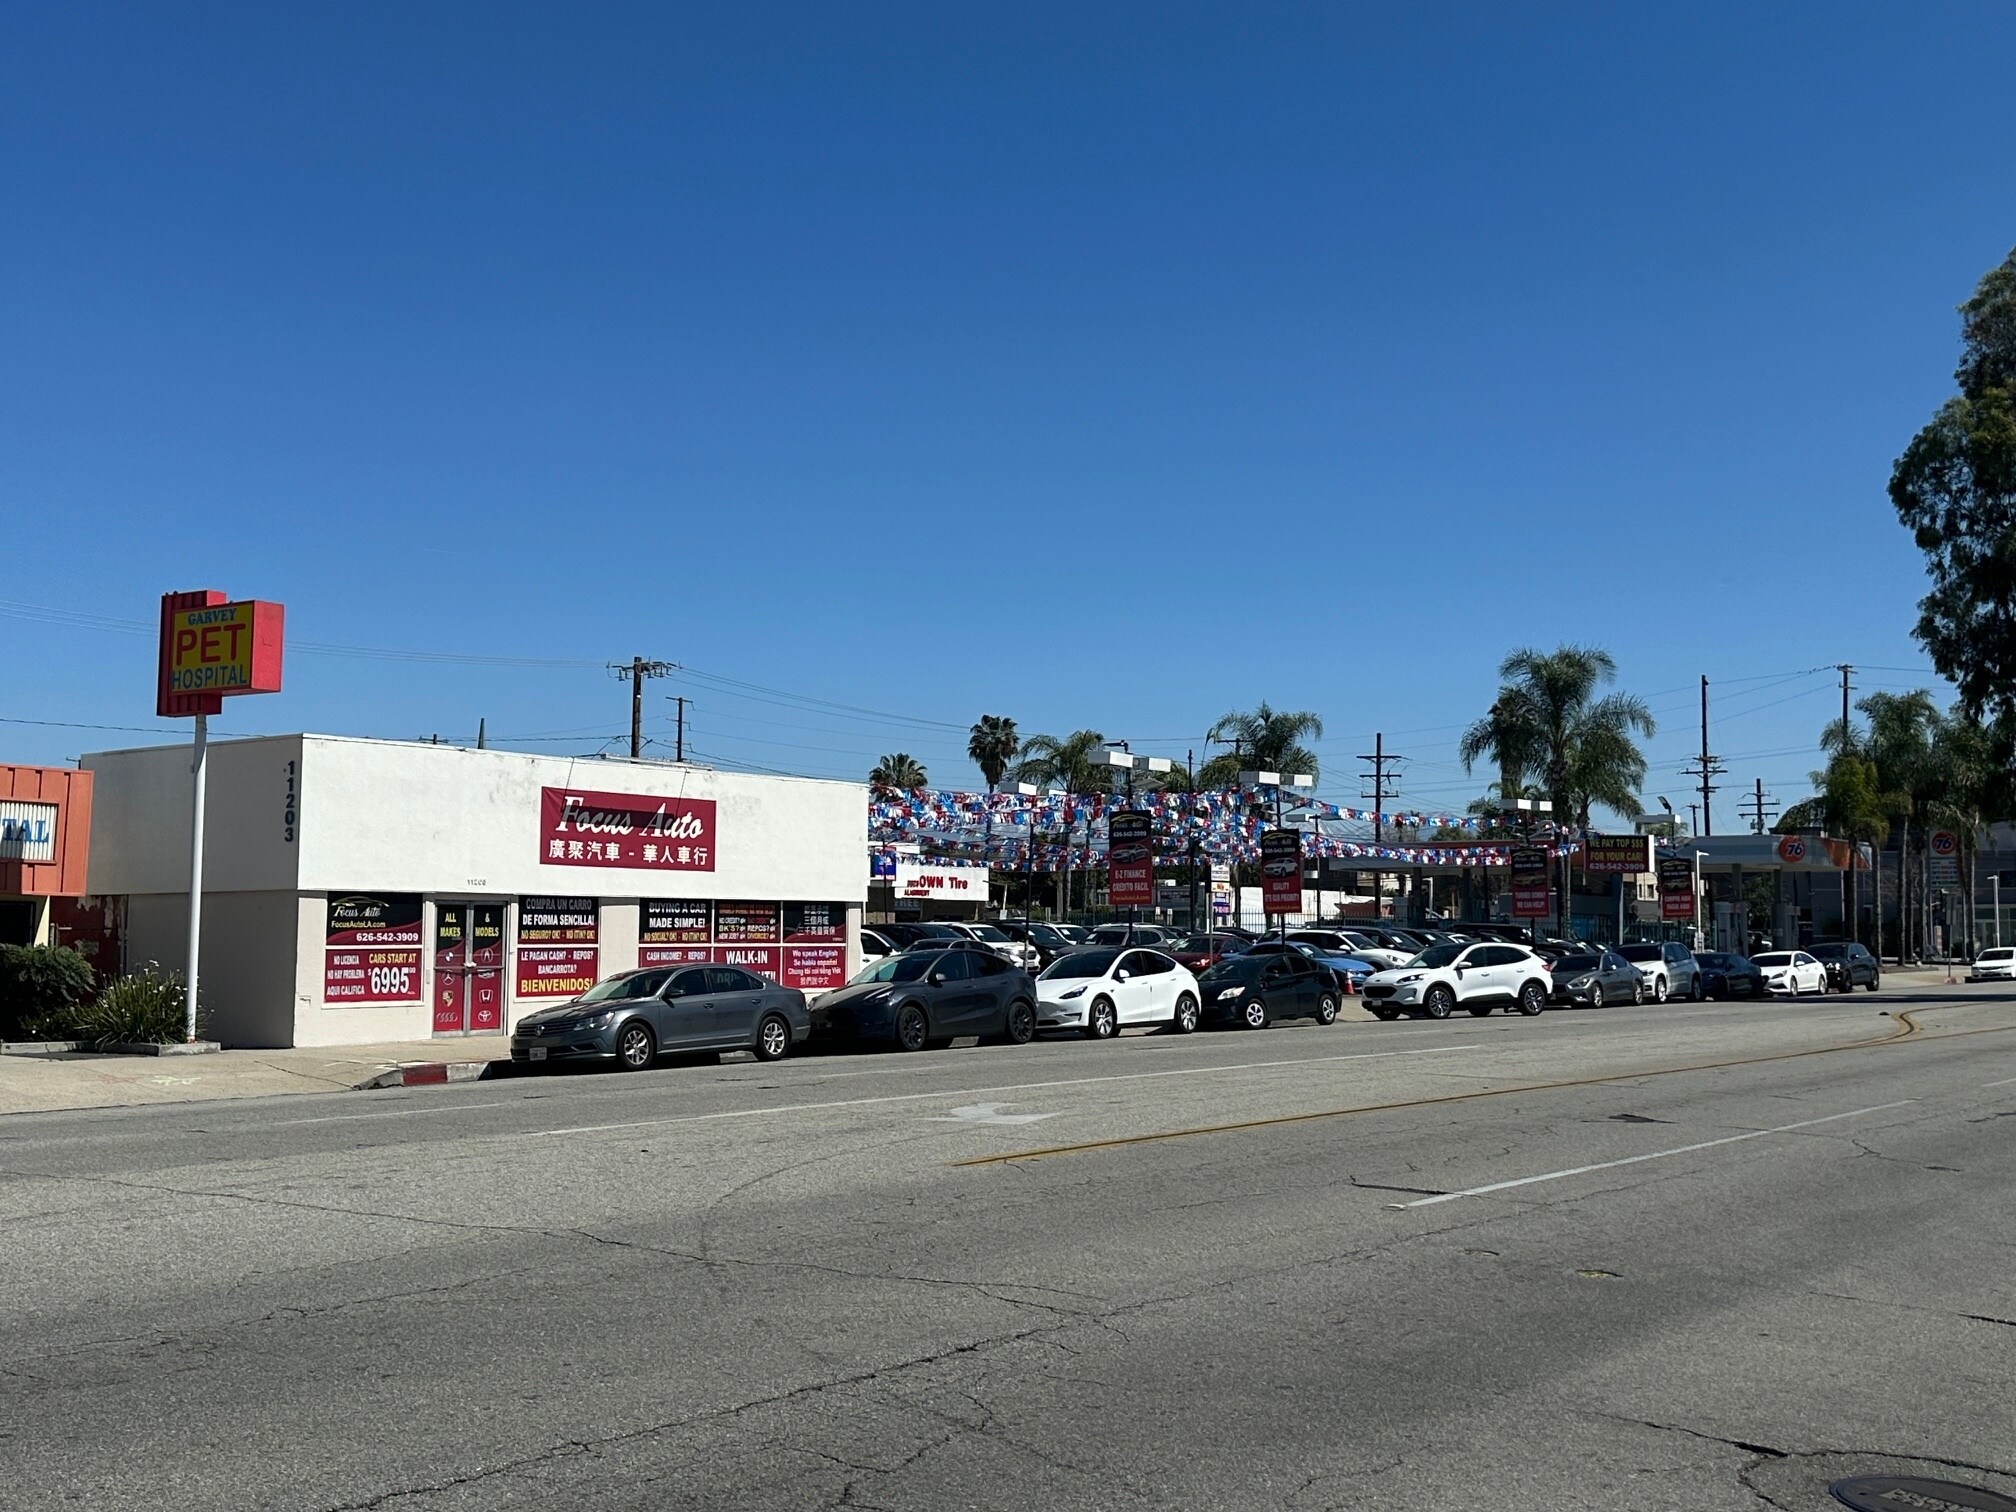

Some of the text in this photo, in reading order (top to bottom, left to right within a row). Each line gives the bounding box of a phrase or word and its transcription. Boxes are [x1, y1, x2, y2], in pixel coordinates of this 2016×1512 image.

[187, 608, 237, 626] GARVEY
[176, 623, 247, 666] PET
[172, 664, 248, 690] HOSPITAL
[284, 760, 296, 842] 11203
[555, 796, 704, 839] Focus Auto
[1590, 838, 1600, 848] WE
[1602, 838, 1614, 848] PAY
[1616, 838, 1630, 848] TOP
[1934, 838, 1952, 849] 76
[548, 839, 620, 861] 廣聚汽車
[643, 844, 708, 865] 華人車行
[1787, 844, 1803, 855] 76
[1590, 852, 1643, 862] FOR YOUR CAR!
[1590, 862, 1645, 870] 626-542-3909
[1124, 870, 1146, 879] FINANCE
[948, 877, 968, 890] Tire
[526, 898, 592, 911] COMPRA UN CARRO
[648, 902, 680, 913] BUYING
[682, 903, 688, 913] A
[690, 903, 707, 914] CAR
[333, 906, 382, 917] Focus Auto
[445, 913, 456, 922] ALL
[485, 913, 490, 922] &
[522, 914, 595, 926] DE FORMA SENCILLA!
[331, 920, 386, 928] FocusAutoLA.com
[649, 918, 706, 928] MADE SIMPLE!
[440, 926, 461, 936] MAKES
[475, 926, 499, 937] MODELS
[521, 930, 528, 939] NO
[529, 930, 551, 939] SEGURO?
[566, 930, 573, 939] NO
[356, 933, 418, 941] 626-542-3909
[644, 932, 650, 942] NO
[369, 953, 417, 963] CARS START AT
[521, 952, 528, 960] LE
[529, 951, 548, 960] PAGAN
[548, 951, 566, 960] CASH?
[573, 950, 594, 960] REPOS?
[646, 952, 660, 960] CASH
[660, 952, 682, 960] INCOME?
[688, 951, 706, 960] REPOS?
[726, 950, 768, 965] WALK-IN
[802, 950, 818, 958] speak
[818, 950, 838, 958] English
[334, 956, 340, 965] NO
[327, 970, 334, 979] NO
[344, 969, 365, 979] PROBLEMA
[538, 964, 577, 974] BANCARROTA?
[341, 985, 365, 995] CALIFICA
[521, 978, 593, 993] BIENVENIDOS!
